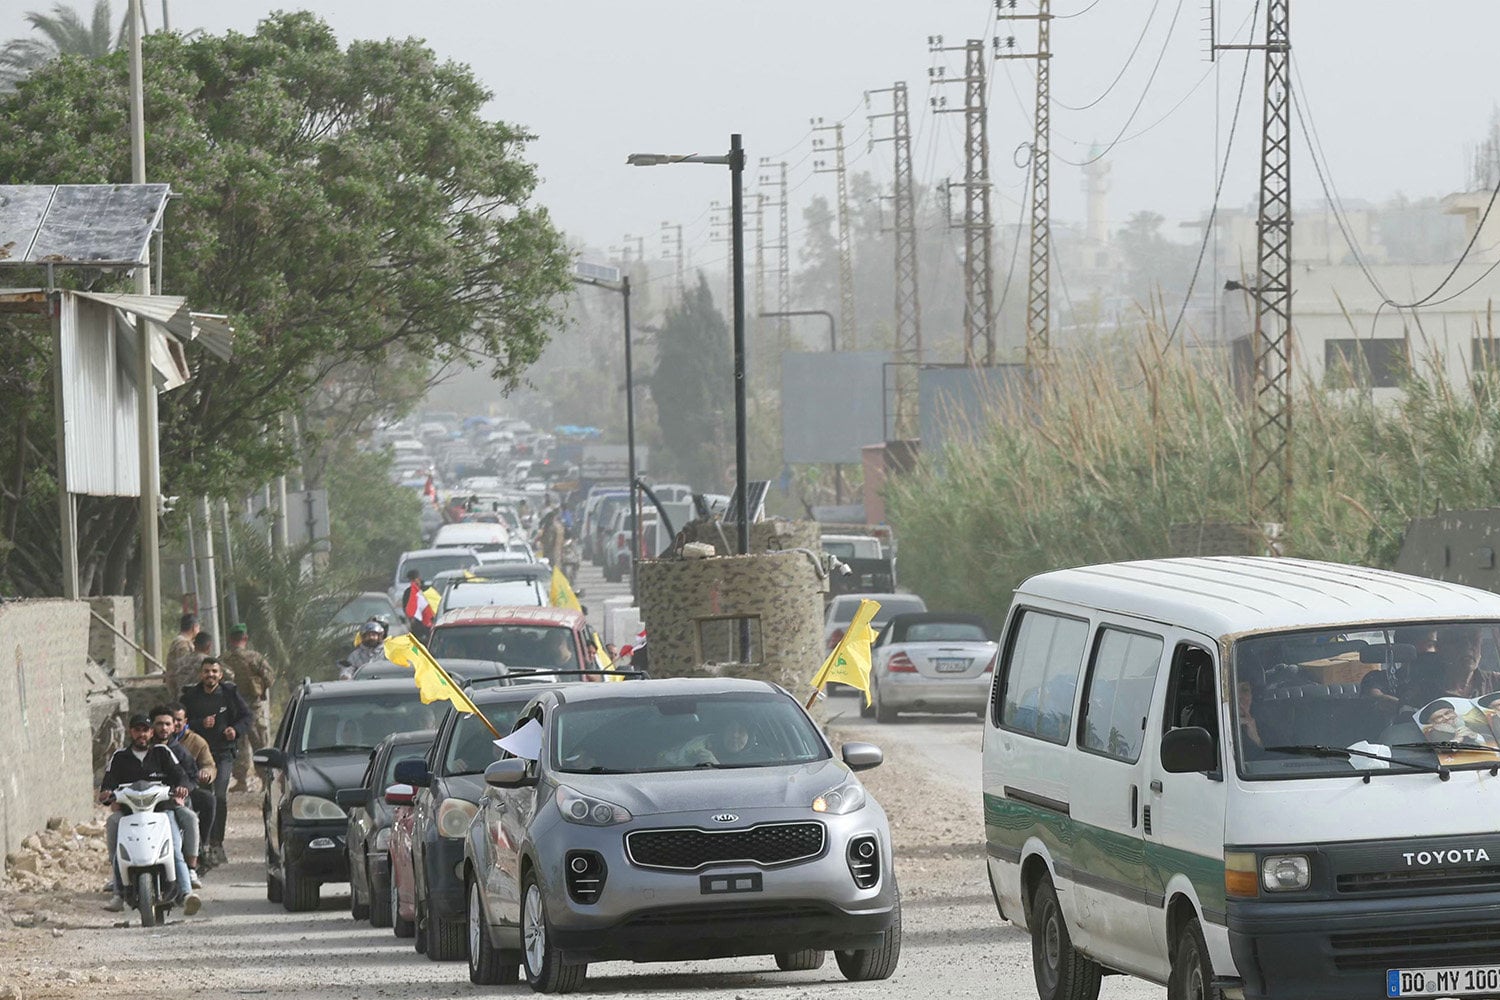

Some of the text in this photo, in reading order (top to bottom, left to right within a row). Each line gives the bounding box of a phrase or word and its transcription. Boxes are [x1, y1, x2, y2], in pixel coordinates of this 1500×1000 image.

[1402, 848, 1490, 866] TOYOTA
[1402, 972, 1425, 992] DO
[1437, 970, 1460, 991] MY
